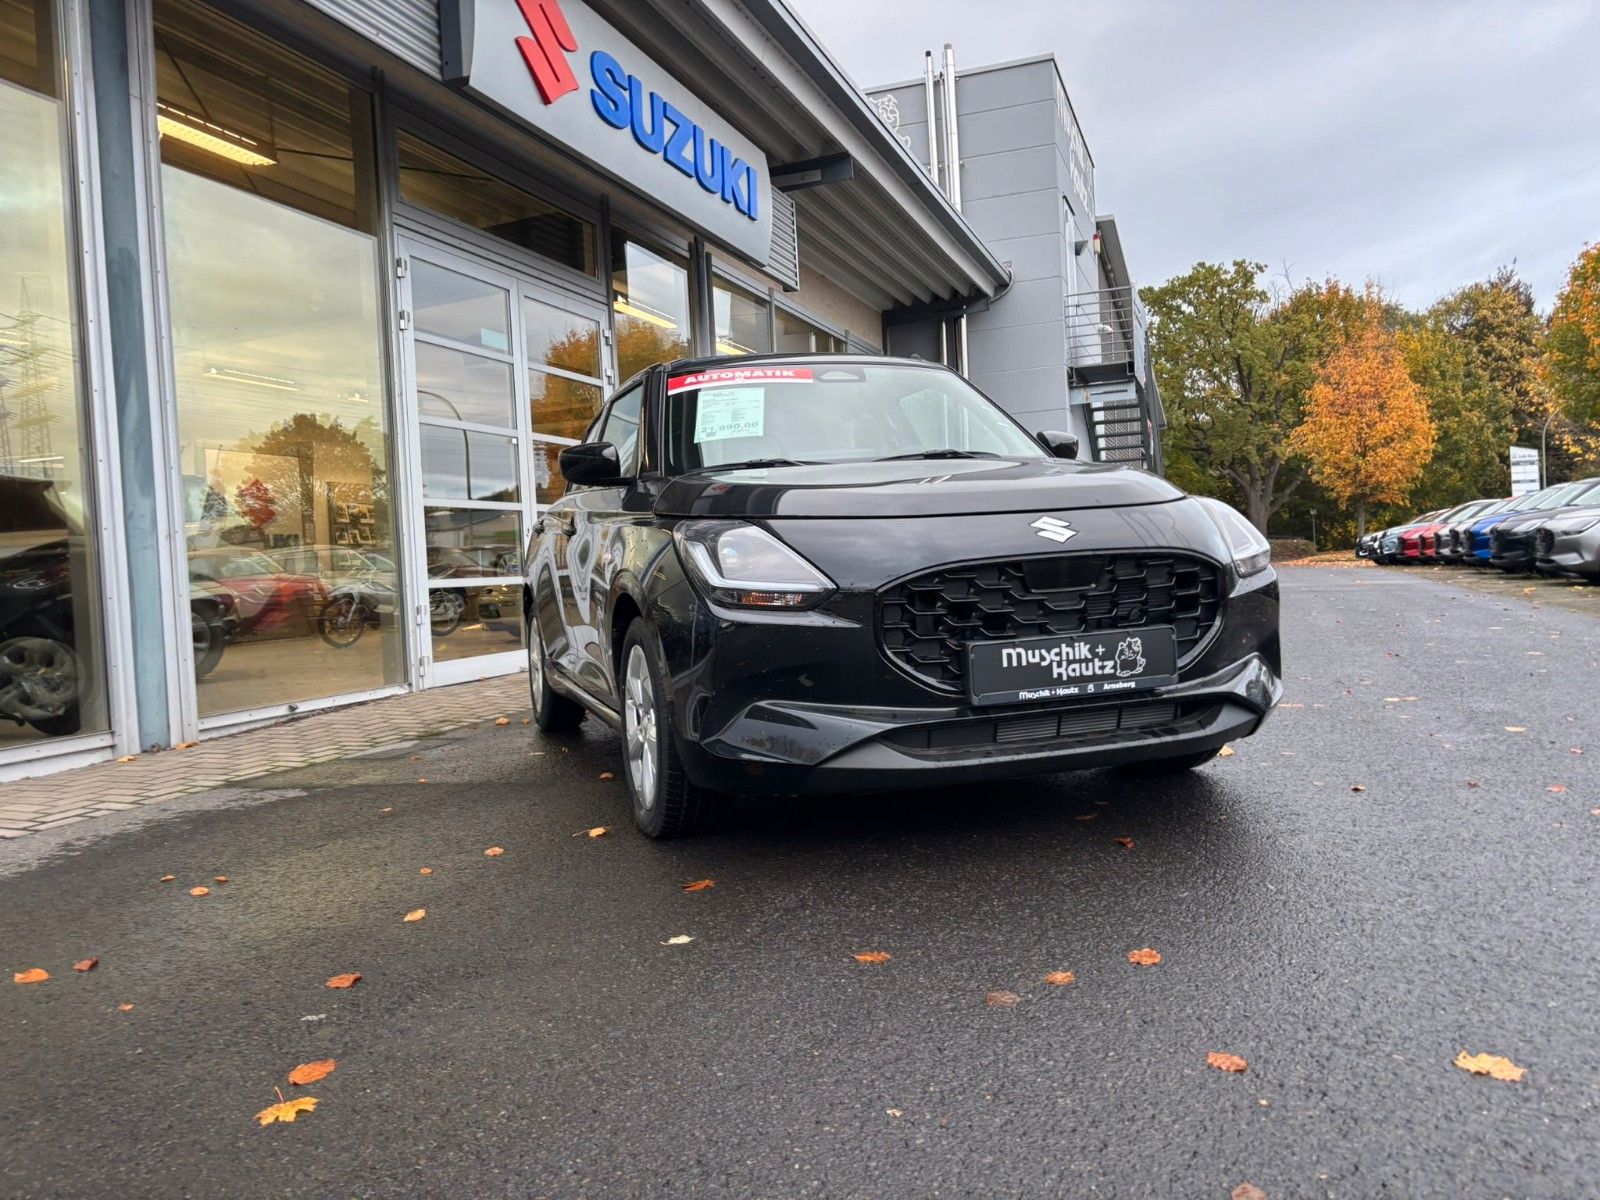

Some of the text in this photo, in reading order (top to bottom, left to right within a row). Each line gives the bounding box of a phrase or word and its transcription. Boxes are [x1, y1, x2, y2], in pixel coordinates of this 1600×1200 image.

[590, 50, 758, 220] SUZUKI
[684, 369, 795, 384] AUTOMATIK
[1001, 642, 1093, 667] Muschik
[1052, 658, 1115, 681] Kautz
[1019, 690, 1050, 700] Muschik
[1103, 681, 1136, 690] Arnsberg
